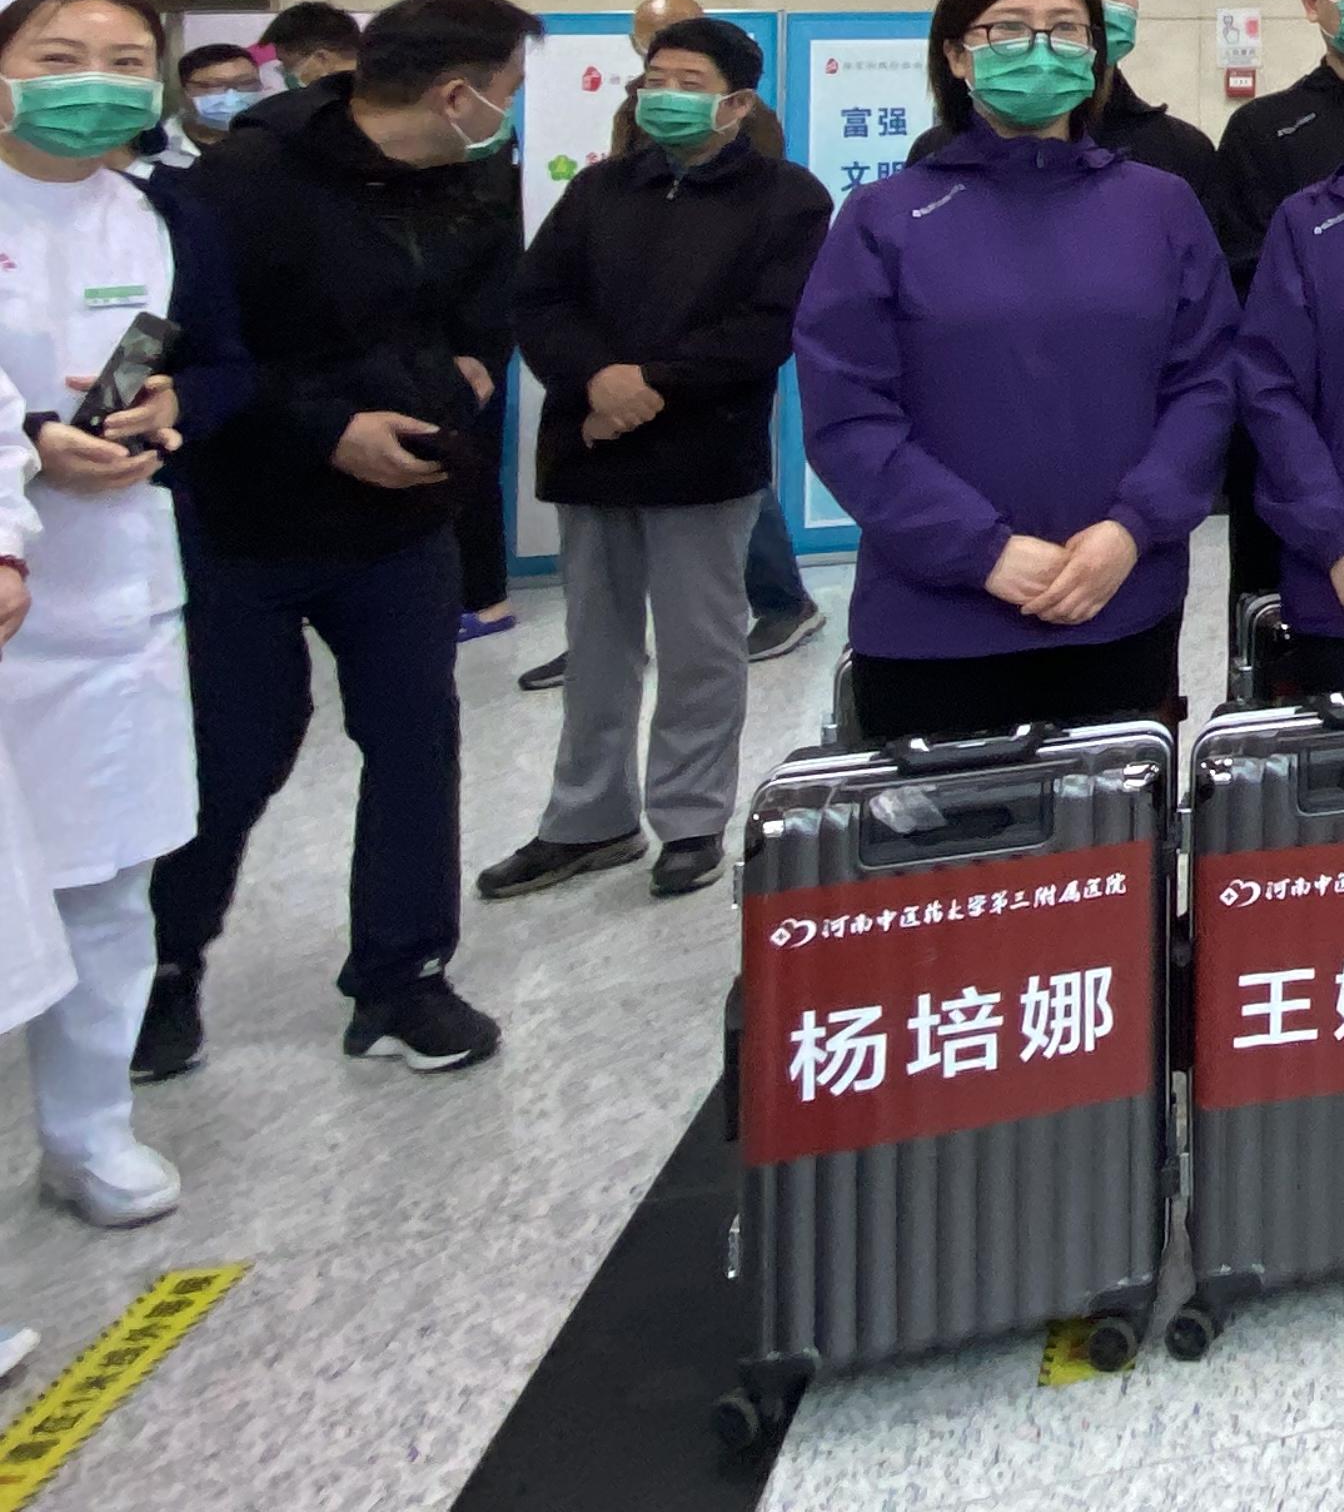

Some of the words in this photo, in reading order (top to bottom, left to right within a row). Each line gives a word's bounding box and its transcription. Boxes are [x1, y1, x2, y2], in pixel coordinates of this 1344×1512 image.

[840, 105, 908, 139] 富强
[821, 871, 1128, 940] 河南中医药大学第三附属医院
[788, 965, 1115, 1103] 杨培娜
